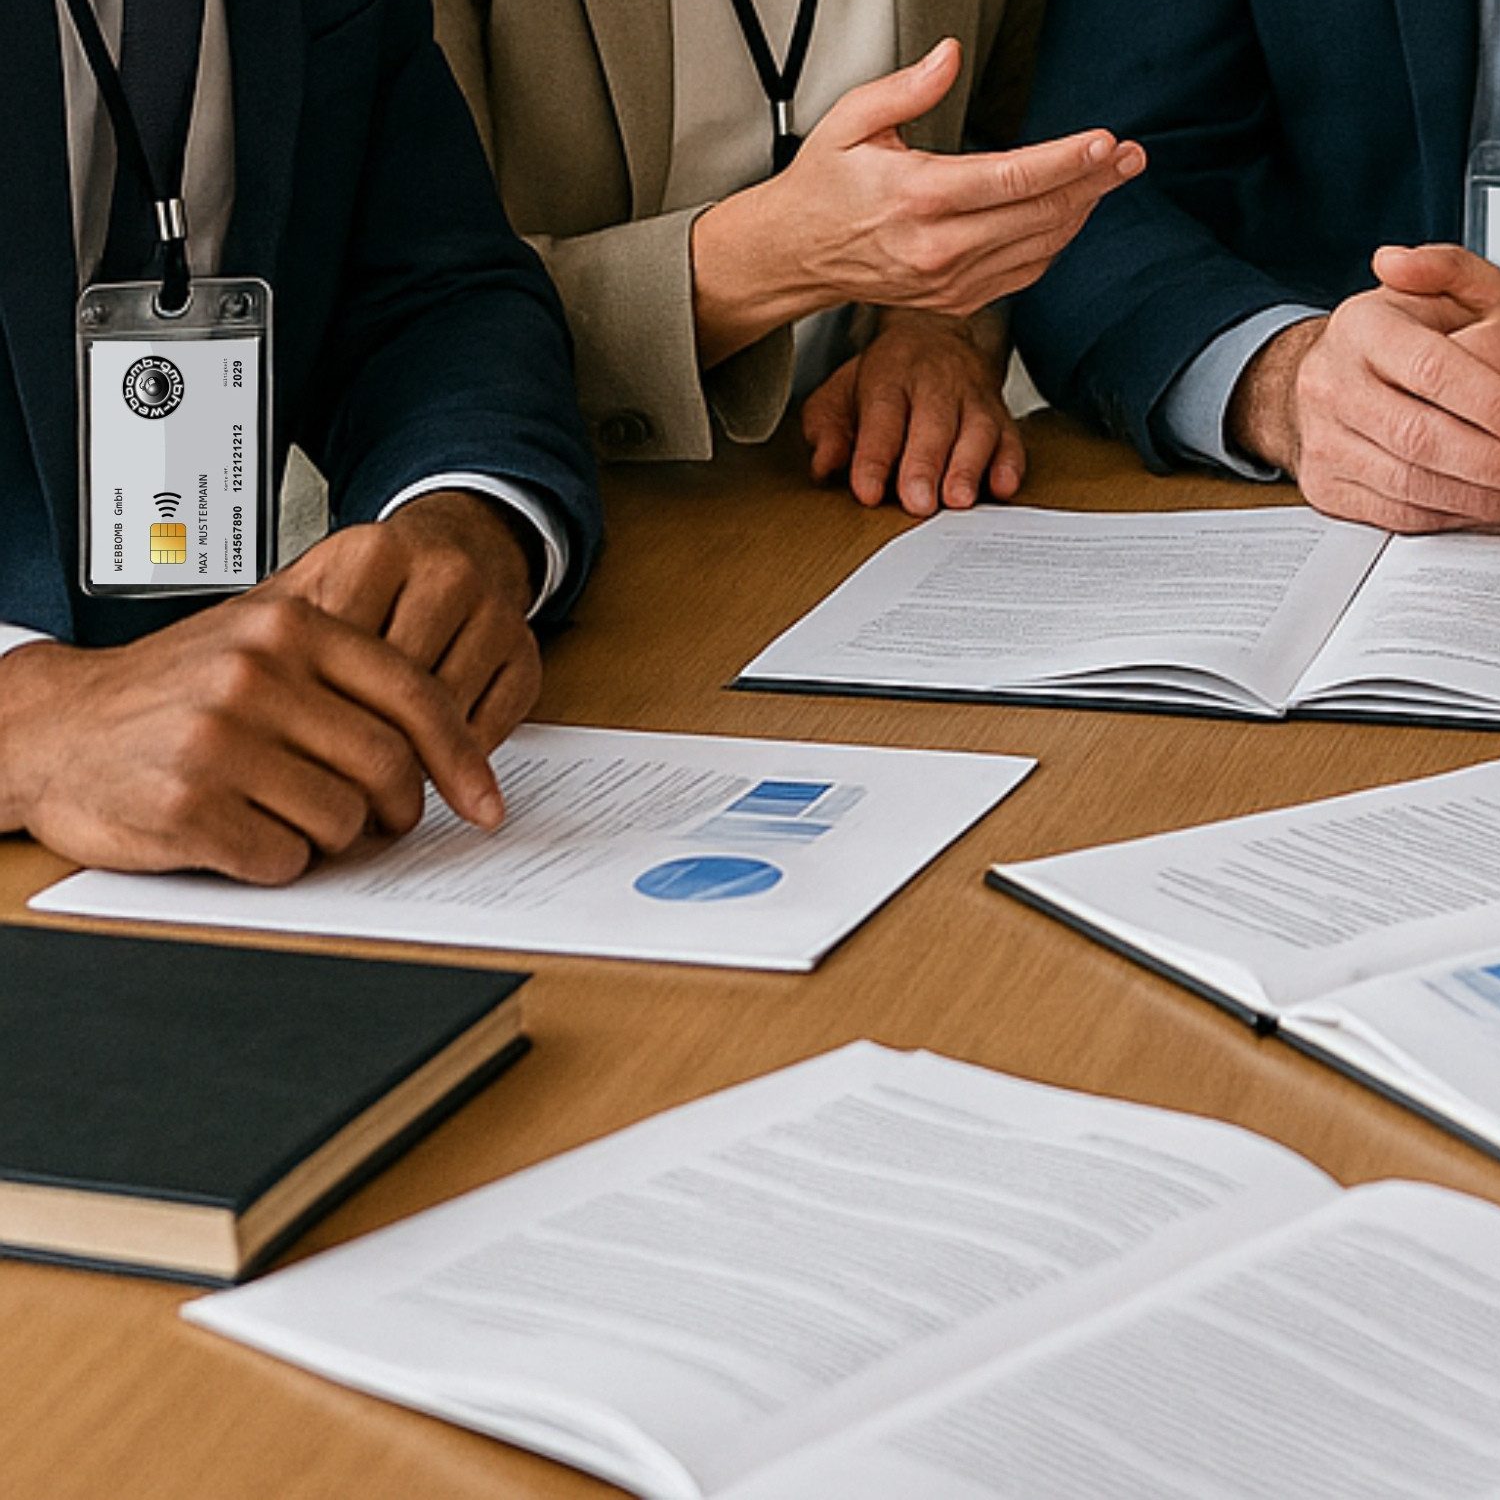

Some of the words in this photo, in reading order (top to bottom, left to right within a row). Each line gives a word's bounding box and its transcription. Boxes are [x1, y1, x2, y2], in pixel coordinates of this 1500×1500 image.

[233, 360, 243, 388] 2029
[233, 424, 243, 493] 1212121212
[114, 487, 123, 516] GmbH
[199, 474, 208, 546] MUSTERMANN
[114, 522, 123, 572] WEBBOMB
[199, 552, 208, 574] MAX
[233, 505, 243, 574] 1234567890
